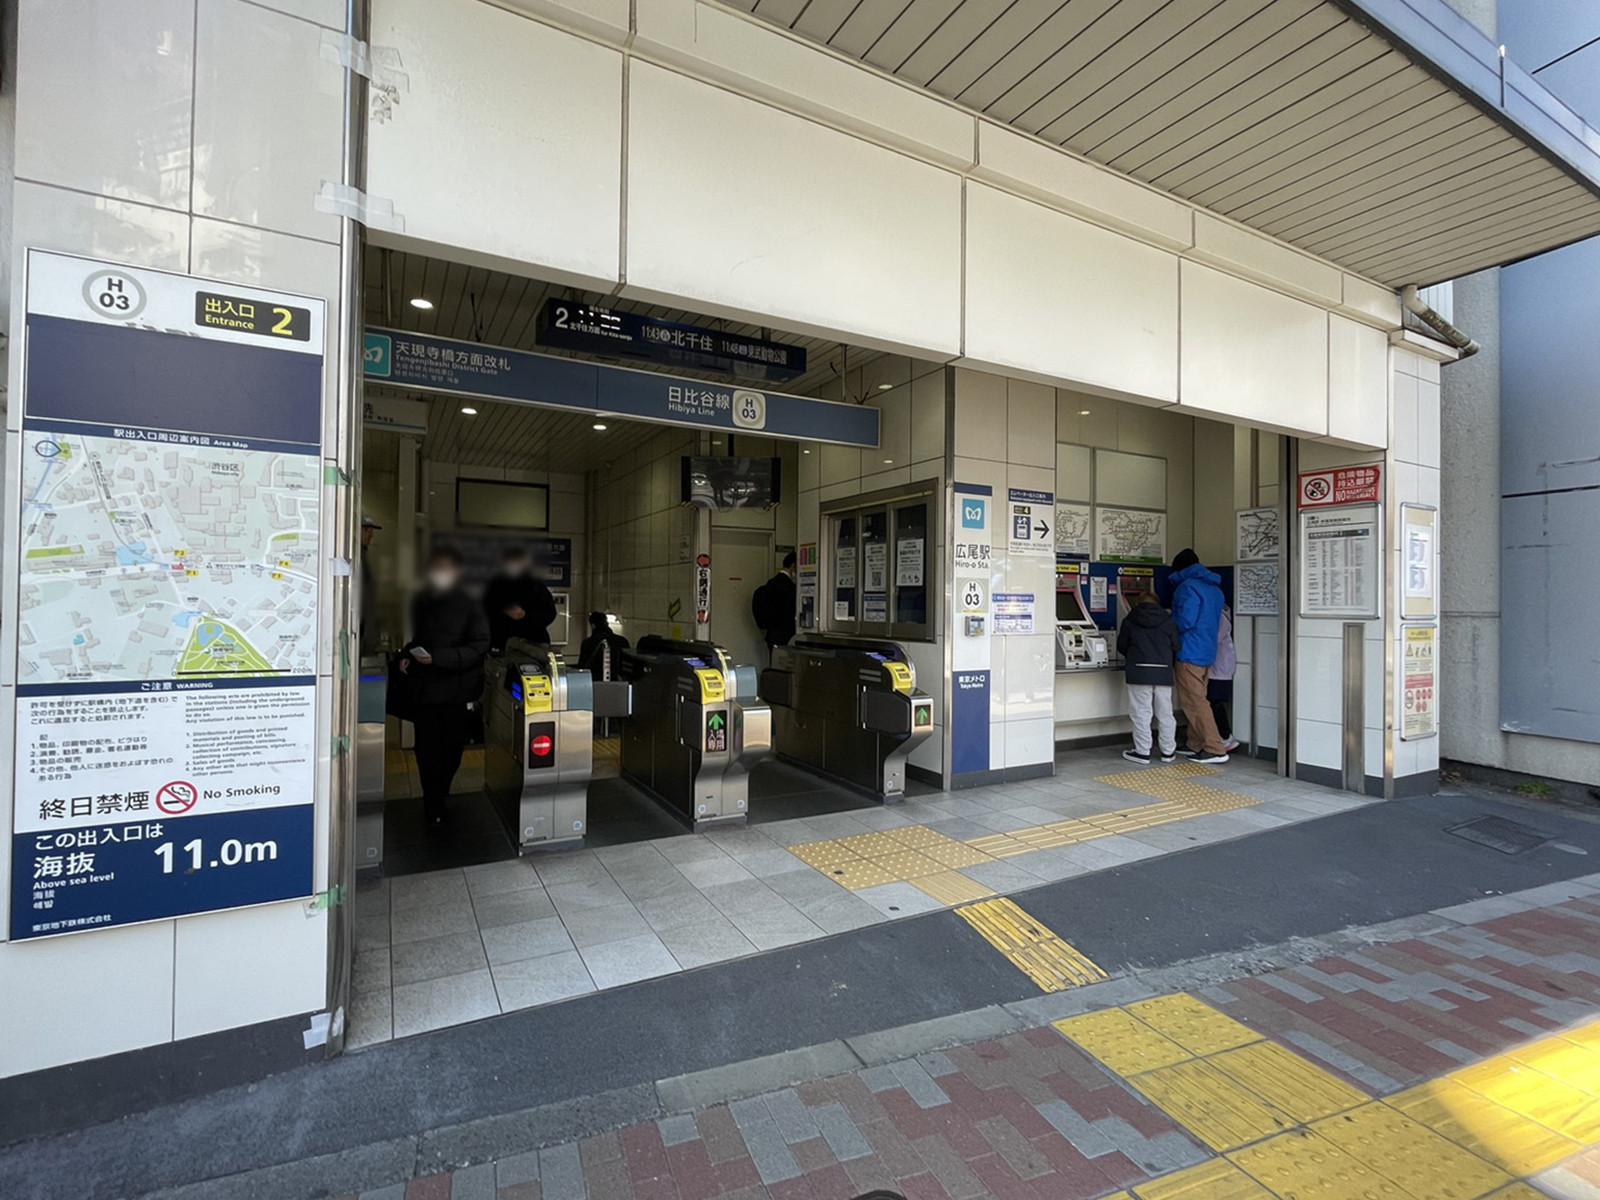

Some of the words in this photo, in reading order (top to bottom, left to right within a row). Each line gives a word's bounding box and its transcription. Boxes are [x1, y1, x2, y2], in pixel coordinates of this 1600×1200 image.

[107, 277, 123, 292] H
[99, 293, 129, 310] 03
[205, 298, 254, 319] 出入口
[205, 315, 254, 329] Entrance
[271, 308, 293, 335] 2
[555, 307, 568, 329] 2
[570, 322, 600, 335] 北千住方面
[672, 330, 713, 351] 北千住
[396, 341, 511, 371] 天現寺橋方面改札
[396, 354, 450, 368] Tengenjibashi
[452, 363, 479, 372] District
[481, 367, 498, 375] Gate
[668, 386, 730, 409] 日比谷線
[746, 398, 753, 408] H
[668, 403, 695, 416] Hibiya
[698, 407, 715, 416] Line
[742, 408, 756, 420] 03
[114, 429, 210, 445] 駅出入口周辺案内図
[232, 441, 248, 449] Map
[1338, 469, 1374, 479] 危険物品
[1336, 490, 1346, 501] NO
[956, 544, 990, 560] 広尾駅
[956, 560, 977, 568] Hiro-o
[978, 560, 989, 569] Sta.
[699, 568, 707, 606] 右側通行
[969, 583, 976, 591] H
[965, 594, 980, 606] 03
[141, 682, 172, 691] ご注意
[176, 682, 213, 690] WARNING
[959, 675, 985, 683] 東京メトロ
[708, 729, 724, 741] 入場
[204, 790, 222, 799] No
[226, 784, 280, 797] Smoking
[40, 791, 149, 820] 終日禁煙
[35, 823, 164, 850] この出入口は
[154, 839, 278, 874] 11.0m
[33, 852, 95, 878] 海抜
[34, 878, 67, 890] Above
[70, 876, 87, 885] sea
[90, 872, 114, 883] level
[32, 914, 111, 932] 東京地下鉄株式会社
